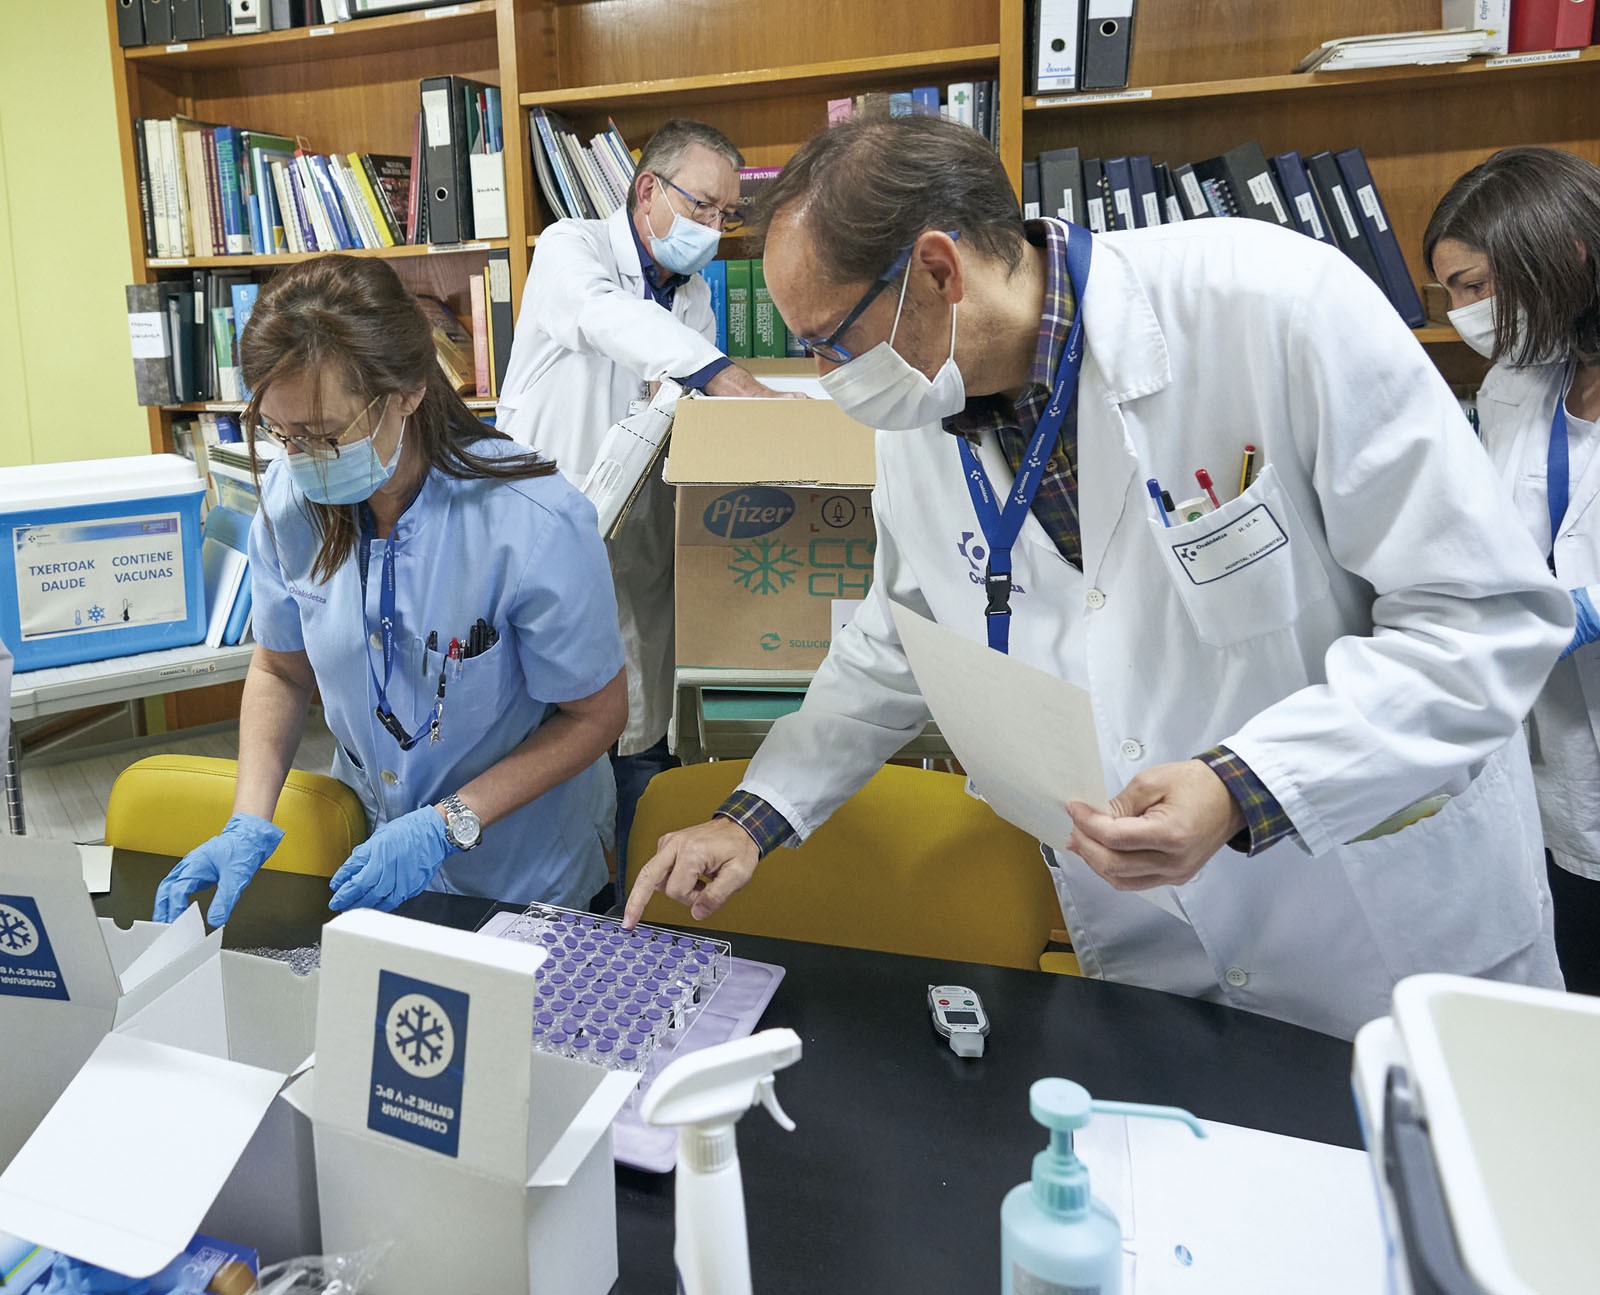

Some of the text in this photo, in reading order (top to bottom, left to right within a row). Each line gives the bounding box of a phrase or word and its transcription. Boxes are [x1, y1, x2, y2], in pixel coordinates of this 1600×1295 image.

[710, 495, 791, 539] Pfizer
[861, 506, 874, 519] T
[112, 550, 174, 567] CONTIENE
[29, 559, 96, 577] TXERTOAK
[114, 567, 174, 584] VACUNAS
[41, 577, 87, 593] DAUDE
[808, 573, 871, 597] CH
[288, 586, 327, 605] Osakidetza
[789, 639, 831, 649] SOLUCIO
[209, 663, 215, 672] 6
[8, 966, 16, 974] Y
[26, 968, 57, 979] ENTRE
[0, 976, 57, 989] CONSERVAR
[395, 1090, 404, 1103] Y
[417, 1096, 454, 1120] ENTRE
[381, 1101, 448, 1135] CONSERVAR
